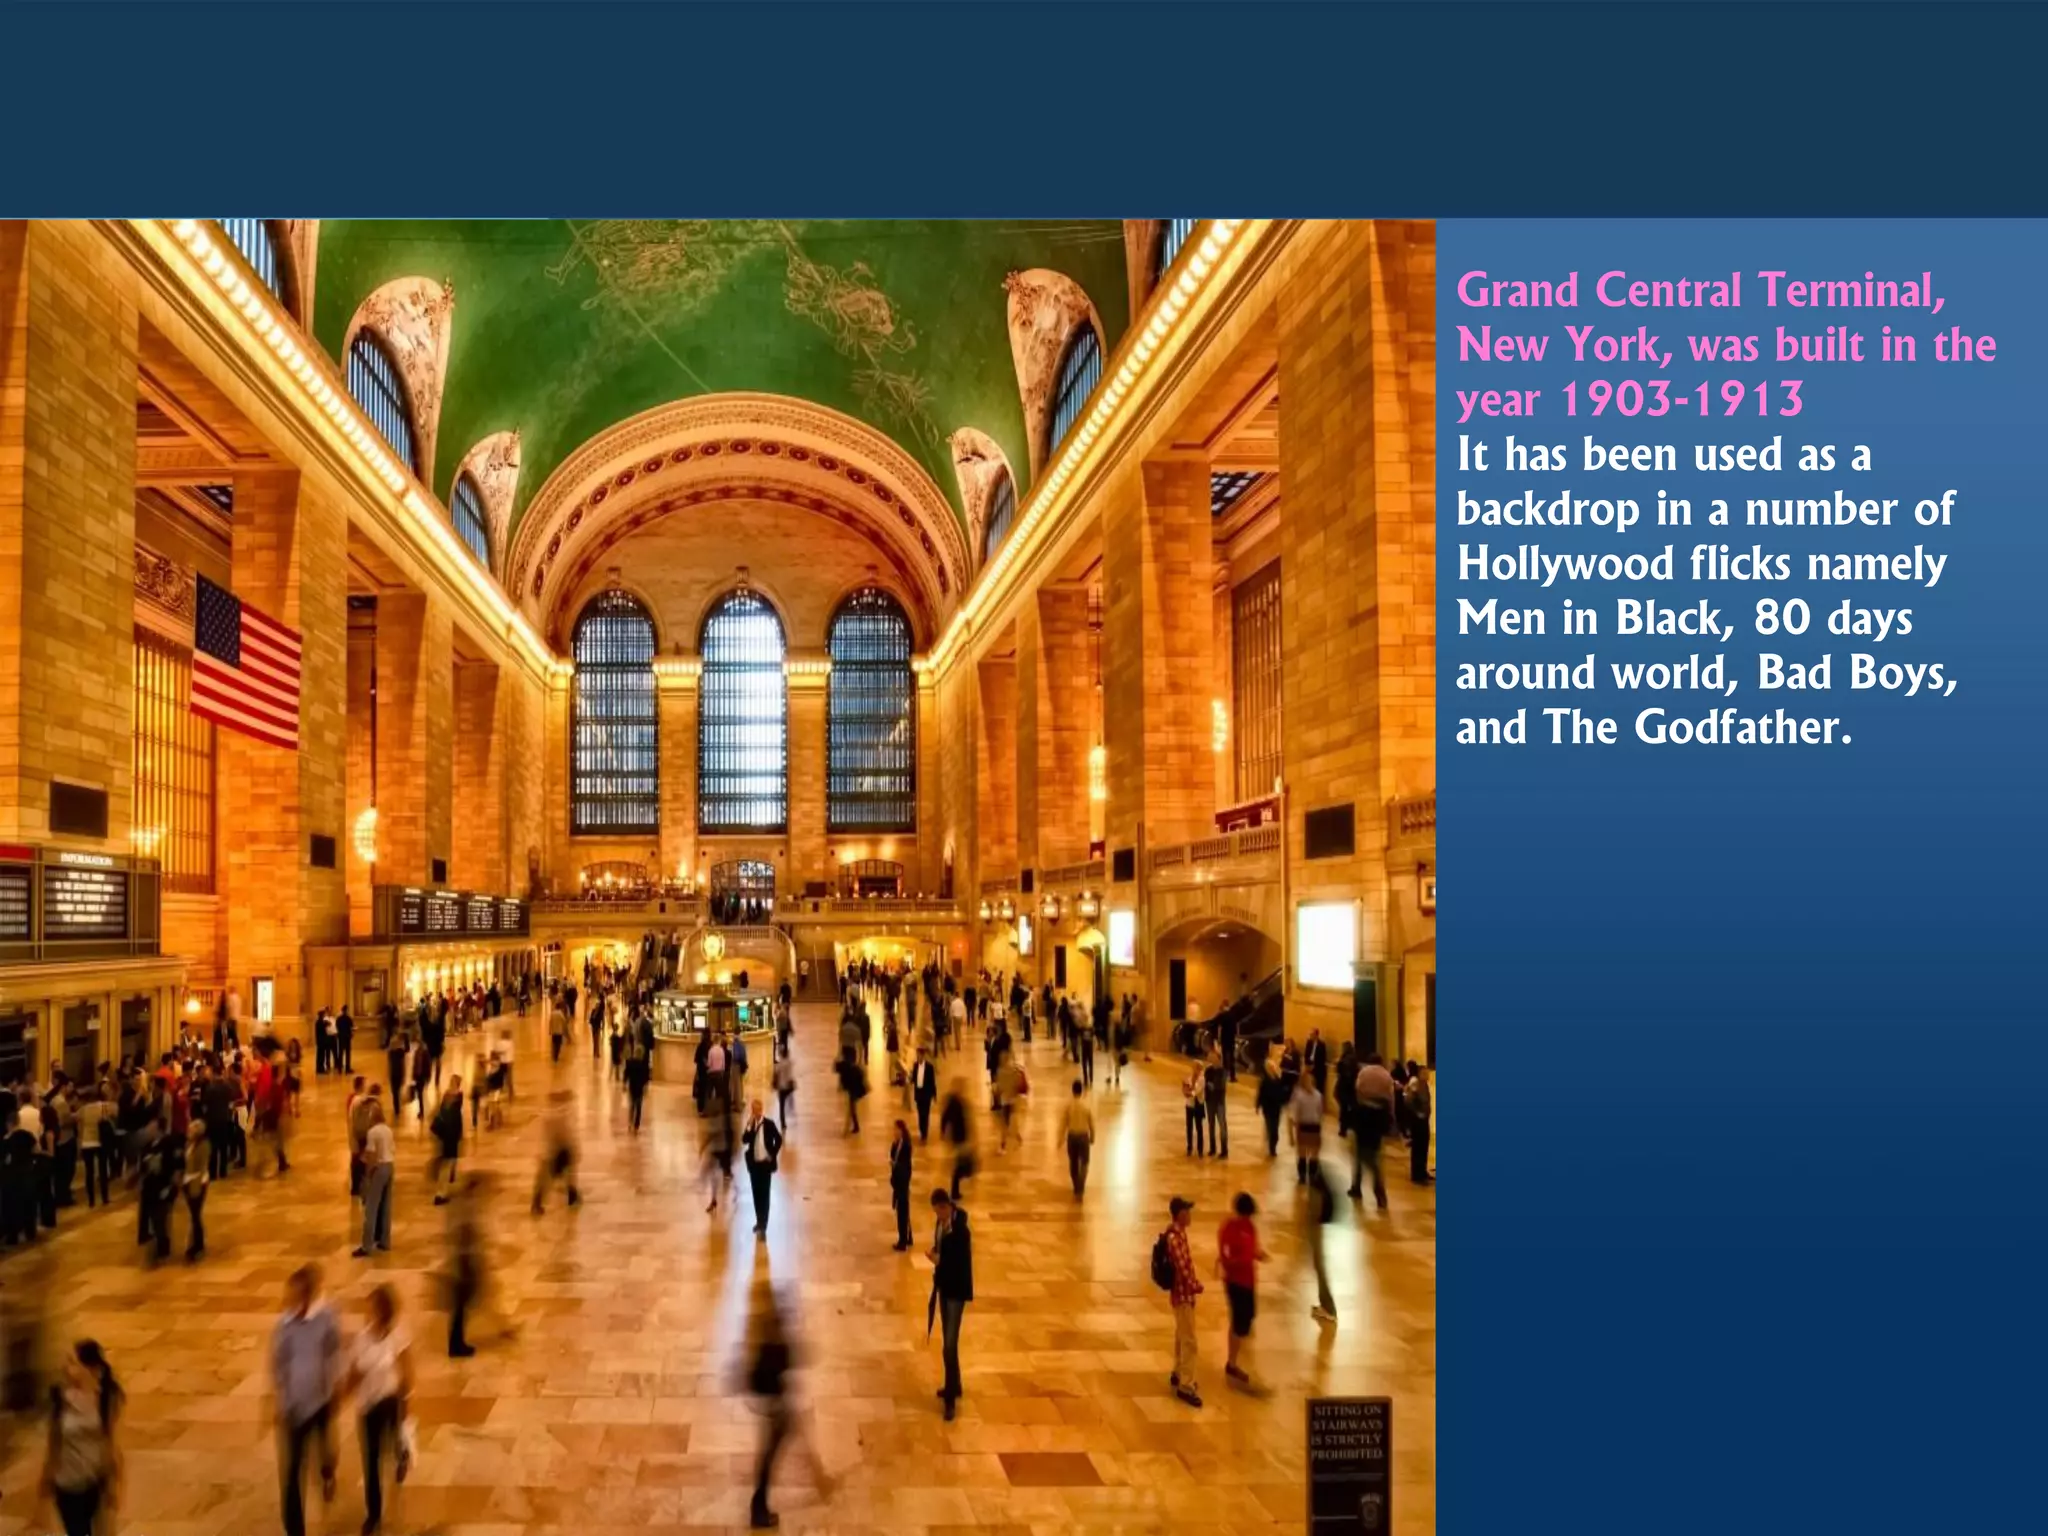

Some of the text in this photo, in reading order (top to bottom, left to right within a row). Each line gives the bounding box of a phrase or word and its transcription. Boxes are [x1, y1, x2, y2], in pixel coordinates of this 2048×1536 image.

[1314, 1405, 1382, 1416] SITTING ON
[1312, 1419, 1383, 1431] STAIRWAYS
[1311, 1432, 1382, 1446] IS STRICTLY
